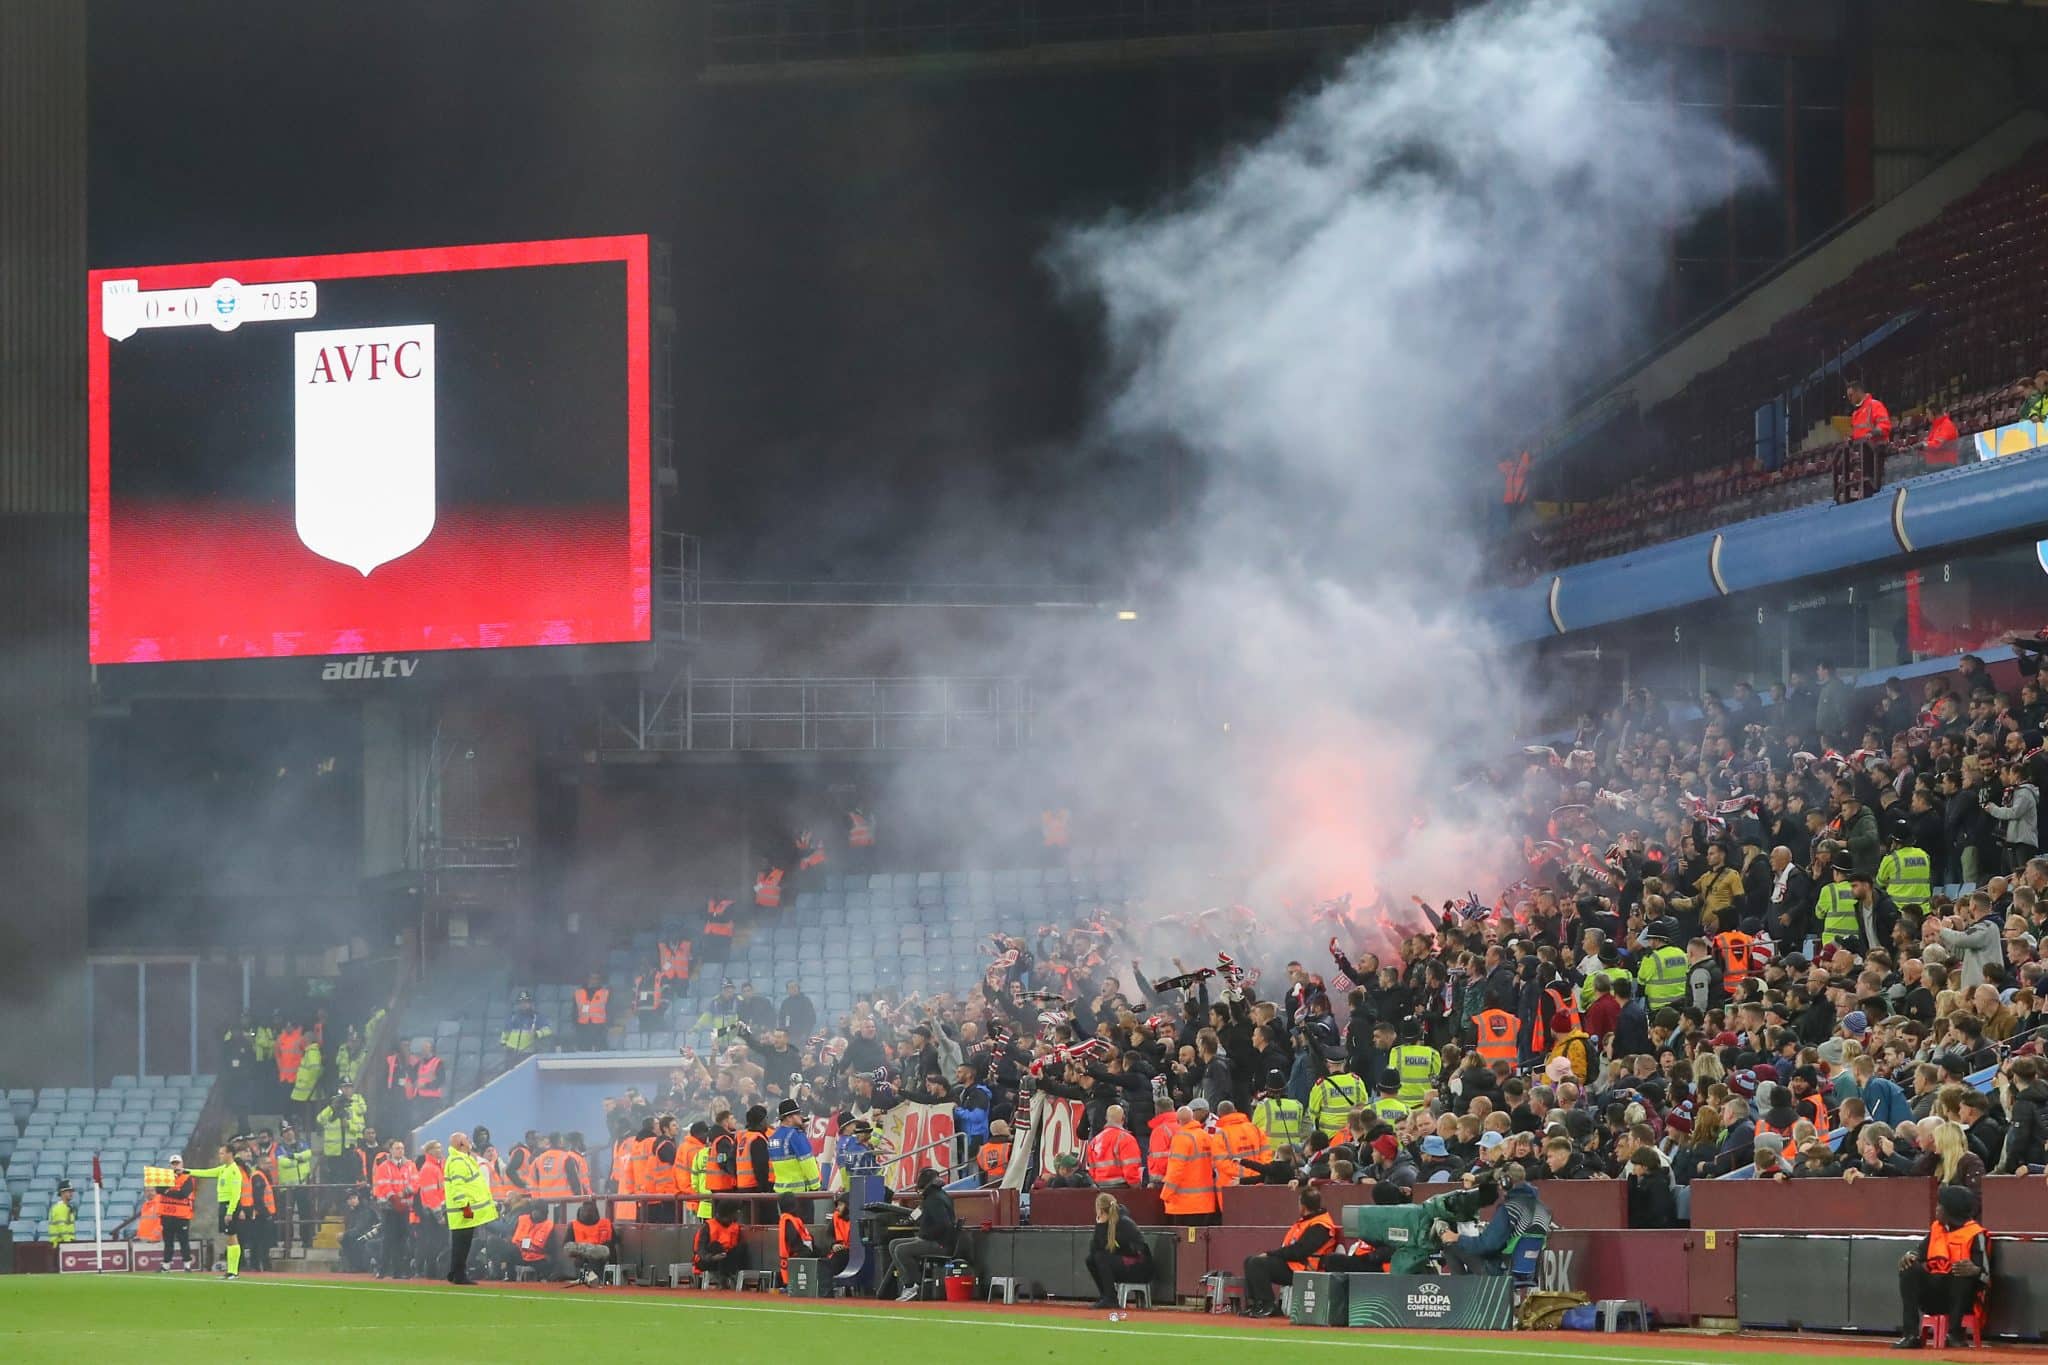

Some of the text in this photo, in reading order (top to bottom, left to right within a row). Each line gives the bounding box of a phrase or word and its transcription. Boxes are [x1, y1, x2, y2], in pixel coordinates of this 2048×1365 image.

[262, 290, 309, 311] 70:55
[308, 340, 422, 384] AVFC
[1943, 564, 1950, 582] 8
[1848, 587, 1854, 604] 7
[1757, 607, 1764, 624] 6
[1674, 626, 1680, 642] 5
[322, 655, 419, 680] adi.tv
[1405, 1056, 1428, 1066] POLICE
[1407, 1294, 1451, 1305] EUROPA
